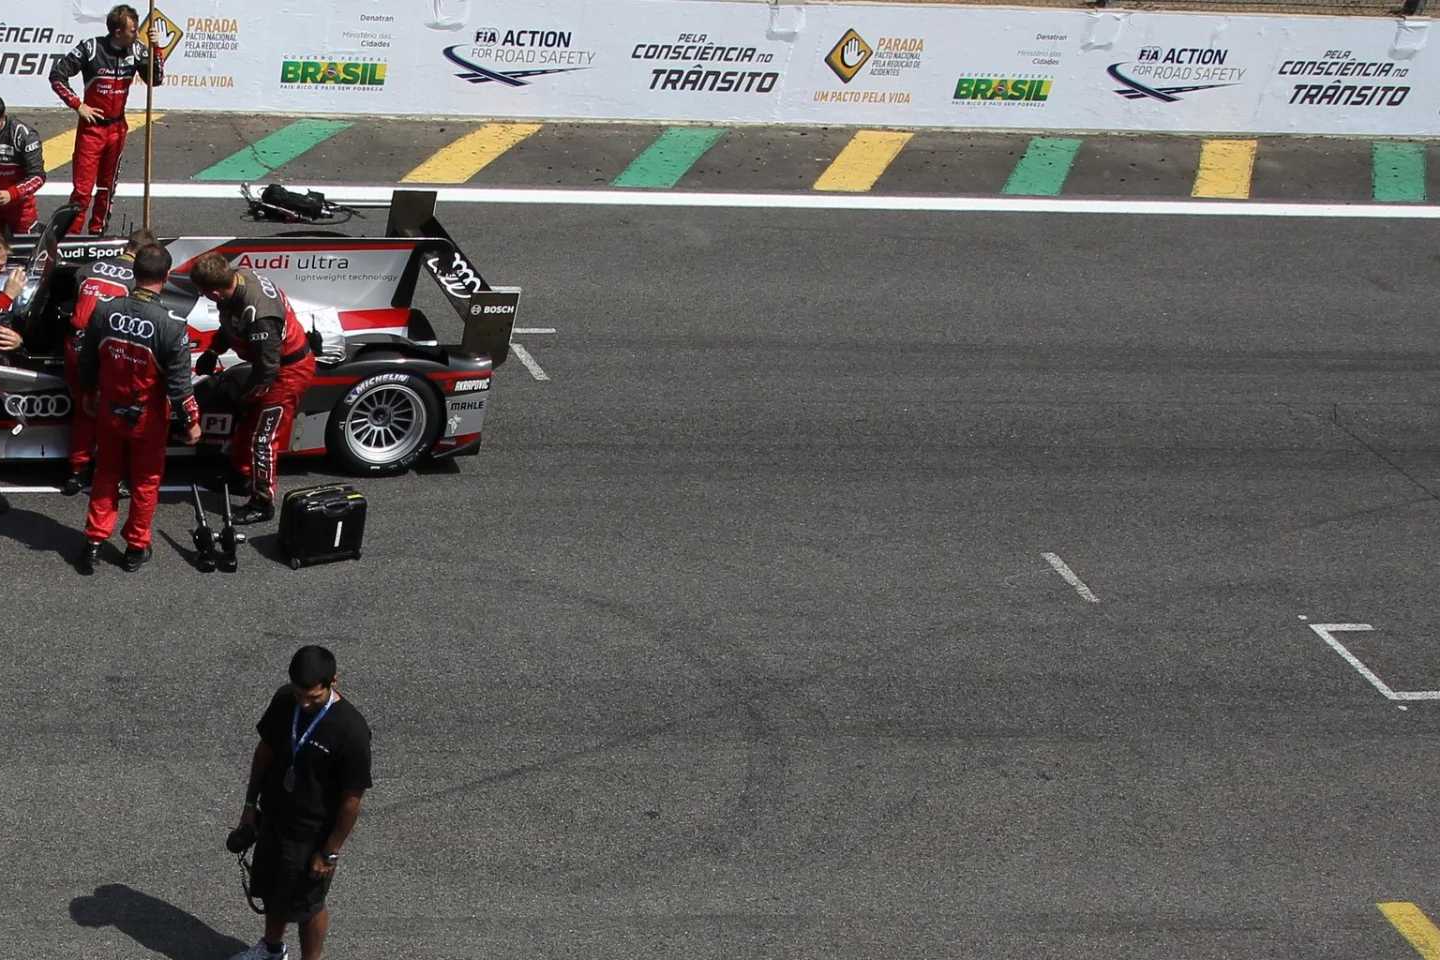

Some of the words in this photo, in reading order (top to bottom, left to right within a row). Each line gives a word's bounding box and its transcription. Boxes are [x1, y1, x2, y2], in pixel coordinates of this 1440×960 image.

[360, 14, 394, 23] Denatran
[186, 18, 238, 33] PARADA
[186, 33, 206, 42] PACTO
[207, 33, 238, 43] NACIONAL
[378, 32, 392, 41] das
[501, 30, 572, 48] ACTION
[677, 33, 707, 43] PELA
[1036, 33, 1067, 41] Denatran
[184, 41, 203, 50] PELA
[231, 42, 239, 51] DE
[361, 40, 391, 49] Cidades
[876, 37, 924, 52] PARADA
[184, 50, 217, 59] ACIDENTES
[471, 47, 492, 59] FOR
[495, 48, 535, 64] ROAD
[538, 49, 596, 65] SAFETY
[631, 42, 757, 63] CONSCIÊNCIA
[875, 51, 892, 59] PACTO
[893, 51, 921, 60] NACIONAL
[1163, 48, 1228, 65] ACTION
[1323, 50, 1351, 59] PELA
[872, 59, 887, 68] PELA
[913, 61, 921, 69] DE
[1032, 58, 1059, 66] Cidades
[1278, 57, 1394, 77] CONSCIÊNCIA
[280, 61, 388, 86] BRASIL
[649, 64, 780, 93] TRÂNSITO
[869, 68, 900, 77] ACIDENTES
[1132, 65, 1153, 76] FOR
[1152, 66, 1192, 80] ROAD
[1194, 67, 1247, 82] SAFETY
[181, 75, 207, 88] PELA
[209, 76, 234, 88] VIDA
[952, 78, 1054, 101] BRASIL
[1288, 79, 1410, 107] TRÂNSITO
[813, 91, 829, 102] UM
[830, 92, 861, 103] PACTO
[862, 92, 886, 103] PELA
[888, 93, 911, 104] VIDA
[88, 246, 124, 260] Sport
[236, 254, 290, 270] Audi
[297, 254, 350, 270] ultra
[295, 273, 347, 281] lightweight
[348, 273, 399, 282] technology
[484, 305, 515, 315] BOSCH
[356, 373, 409, 394] MICHELIN
[450, 400, 485, 411] MAHLE
[205, 416, 228, 432] P1
